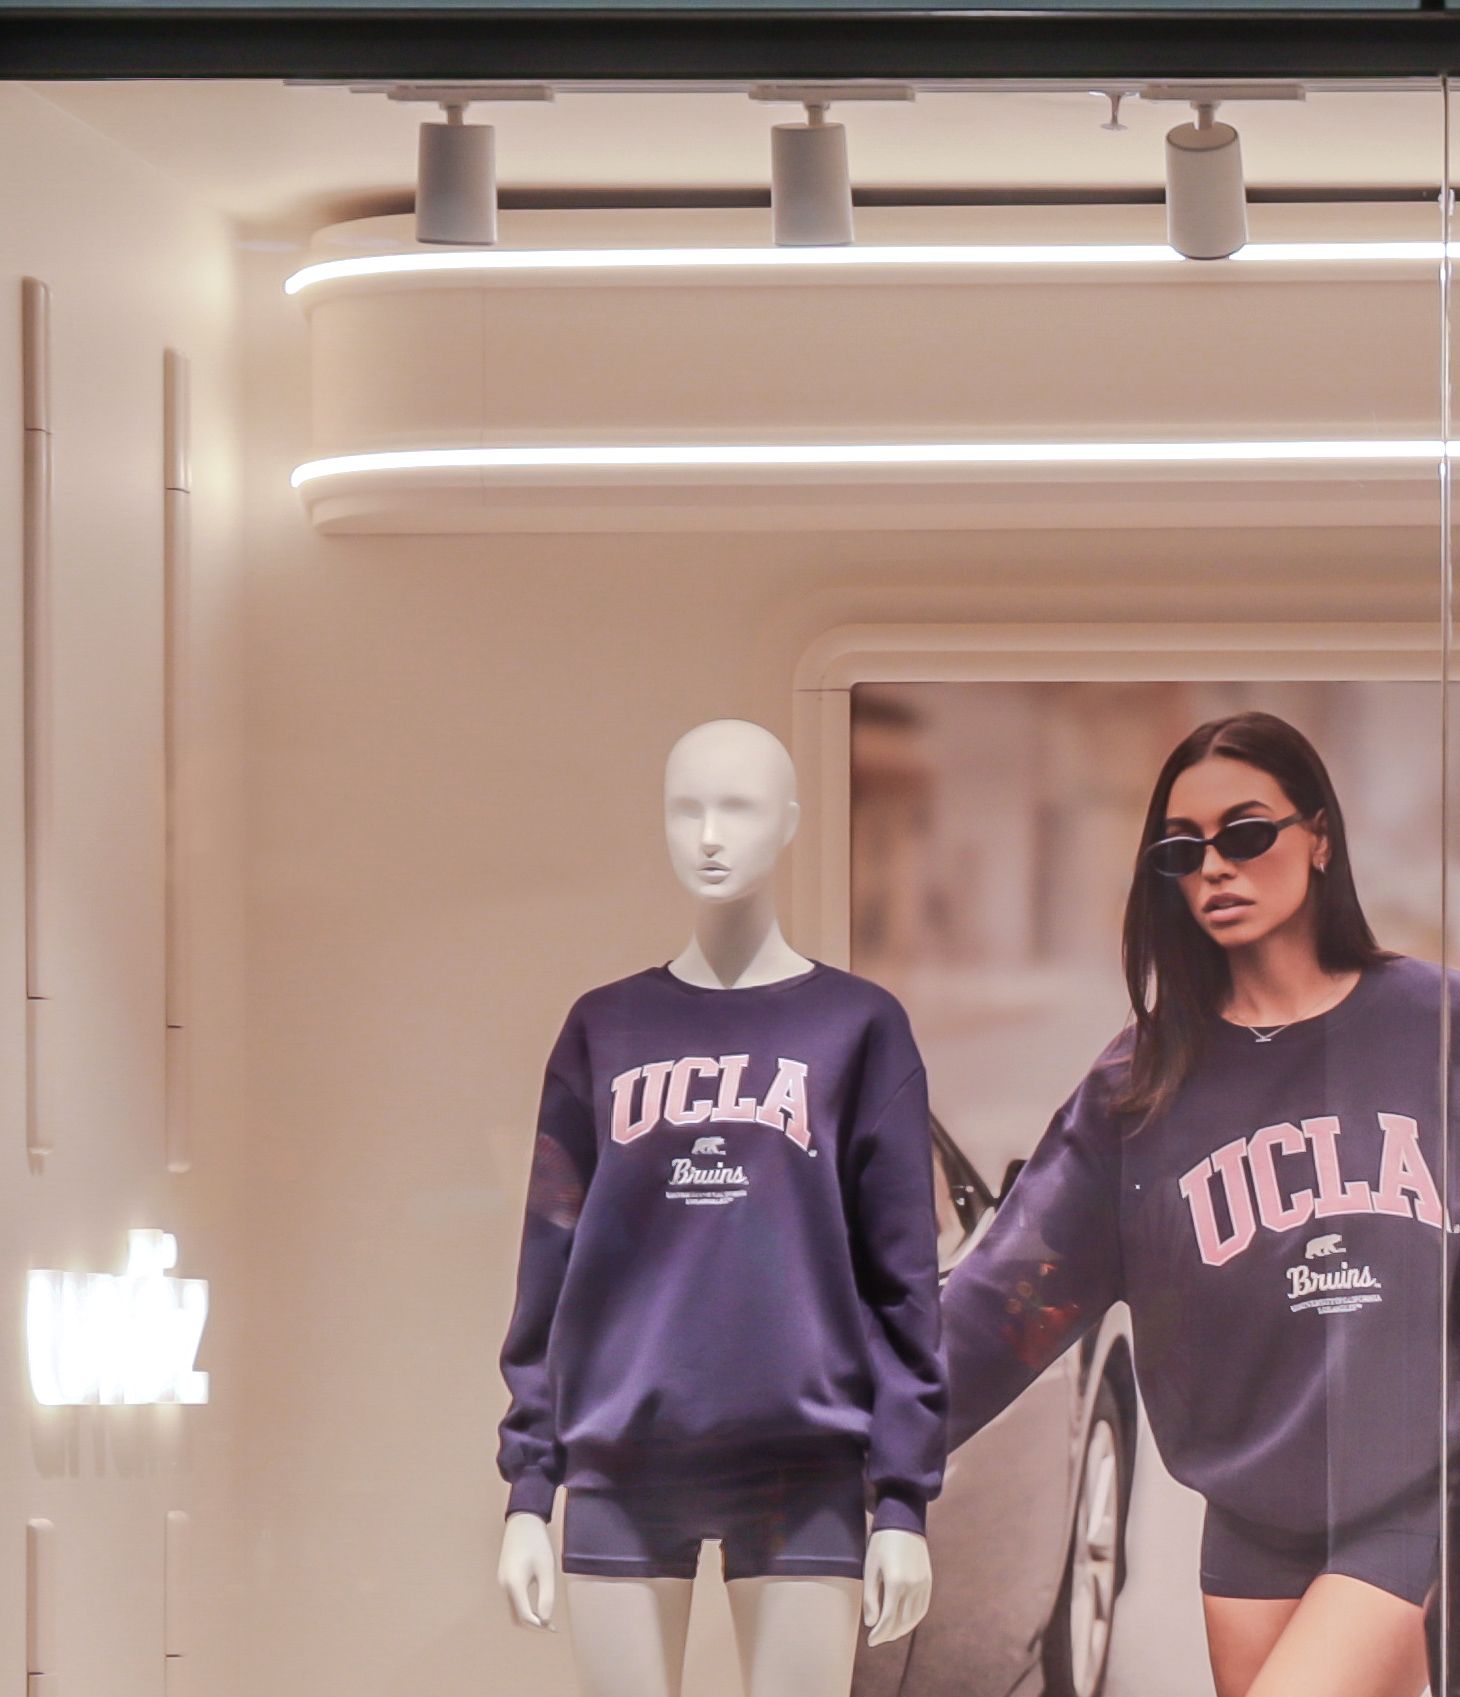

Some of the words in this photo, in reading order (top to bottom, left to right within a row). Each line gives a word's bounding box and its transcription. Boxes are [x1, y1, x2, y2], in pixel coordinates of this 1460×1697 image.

[611, 1054, 812, 1152] UCLA
[669, 1158, 749, 1185] Bruins
[1178, 1112, 1452, 1267] UCLA
[1286, 1262, 1377, 1298] Bruins
